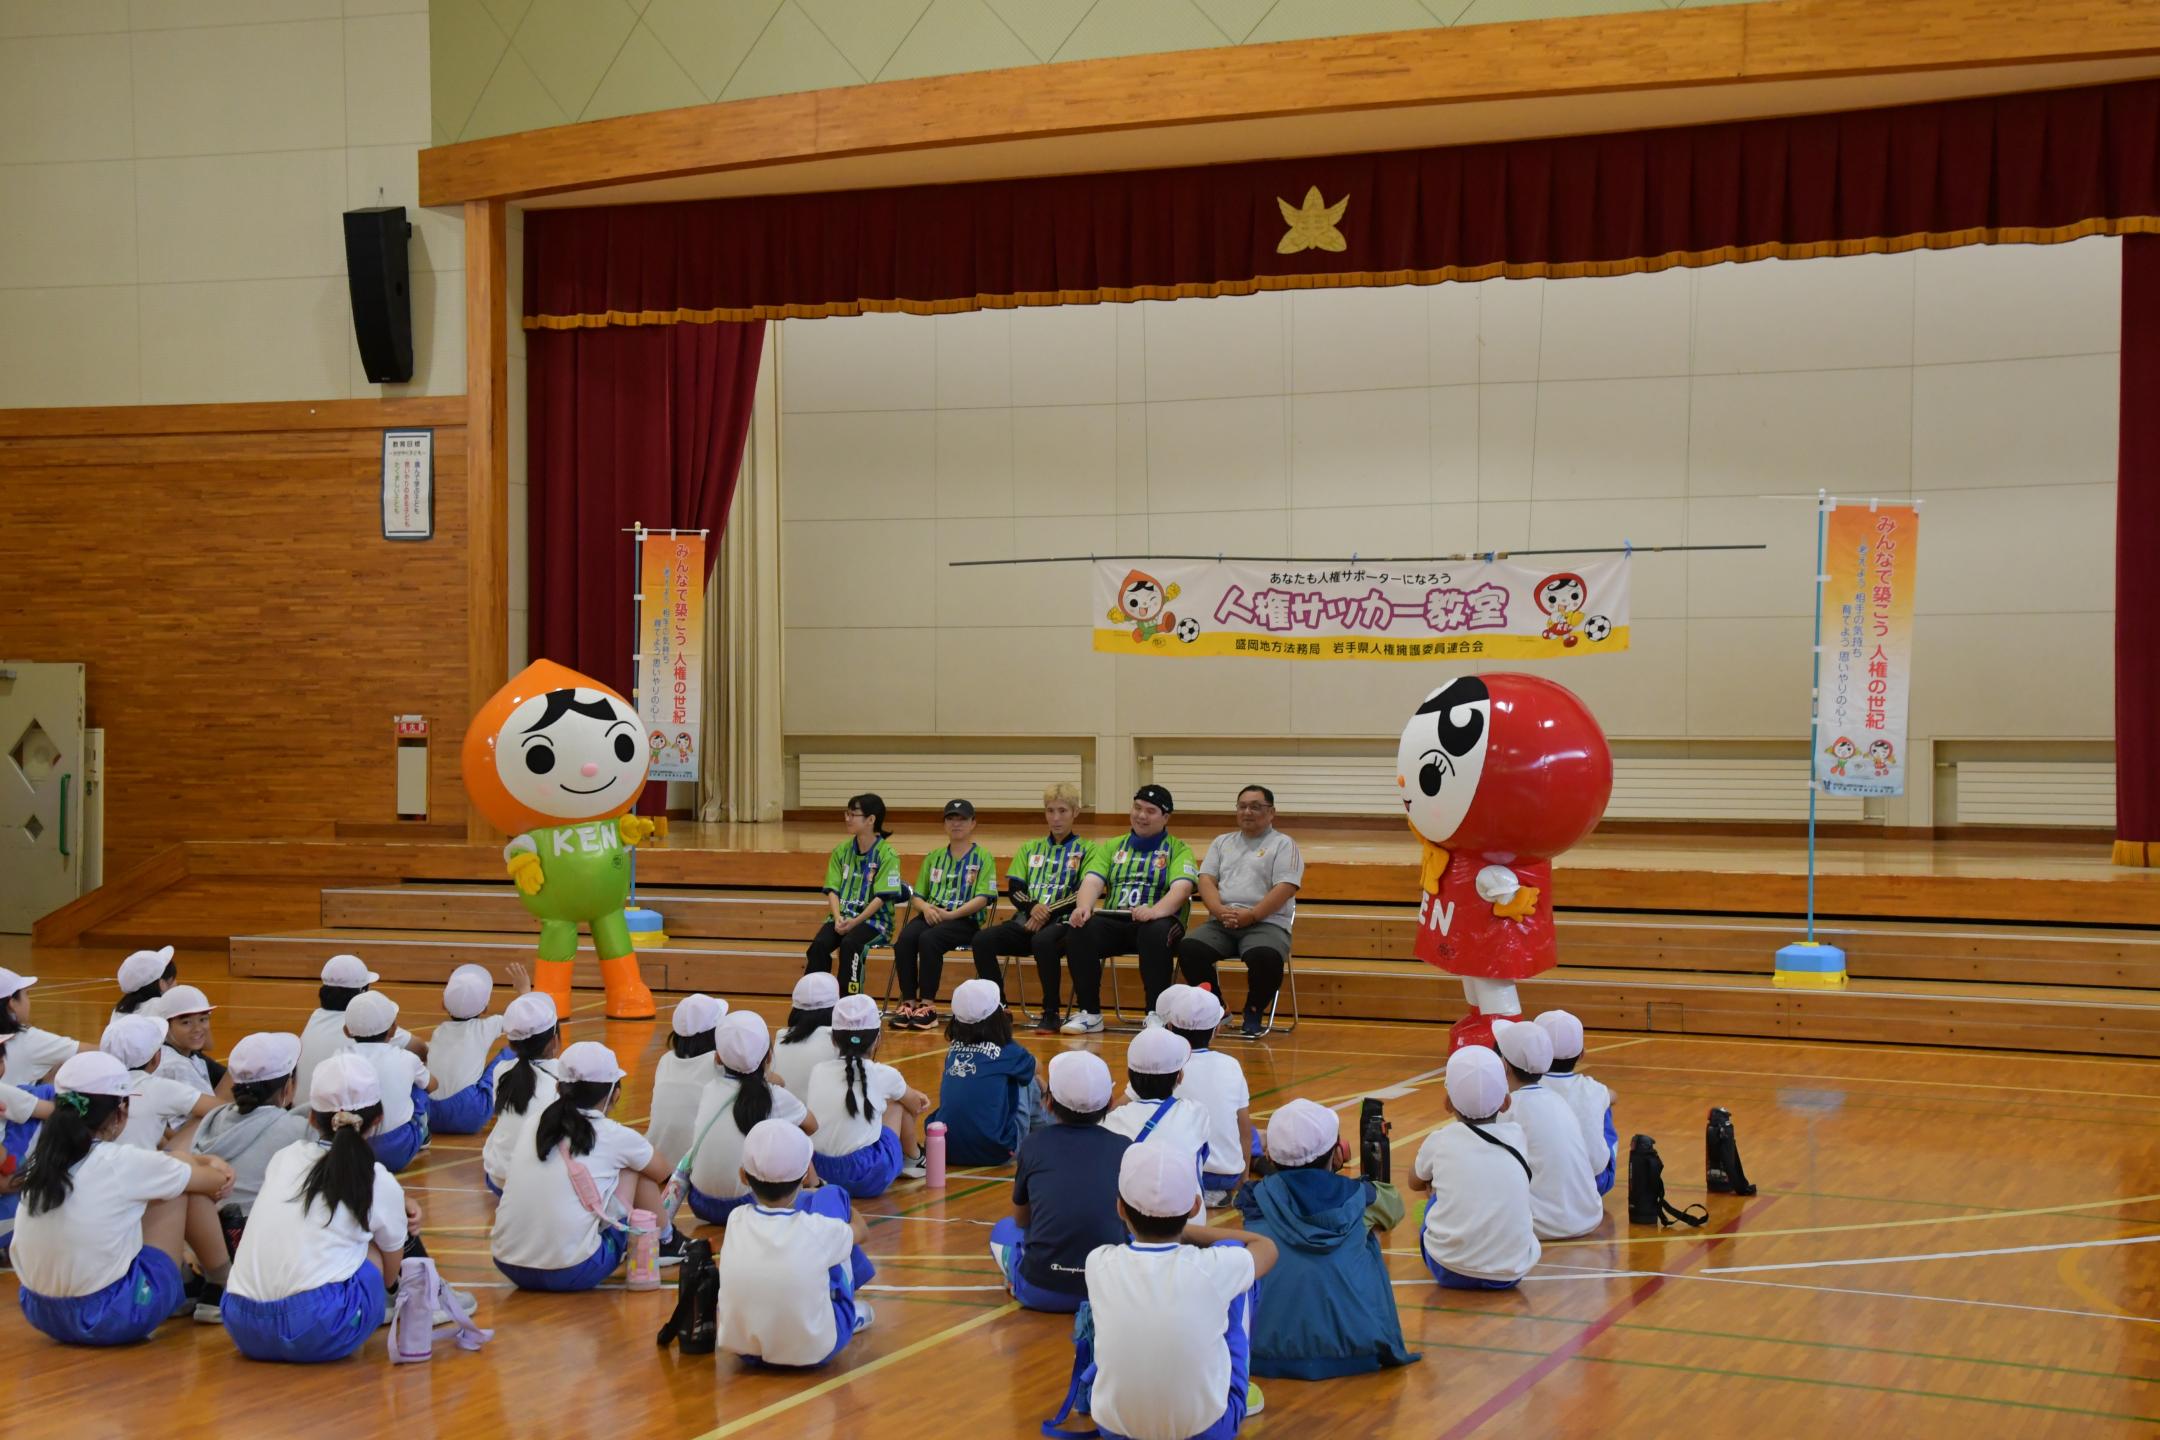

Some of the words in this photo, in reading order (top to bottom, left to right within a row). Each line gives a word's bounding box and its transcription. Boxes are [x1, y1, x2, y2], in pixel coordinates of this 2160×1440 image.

[1270, 569, 1452, 585] あなたも人権サポーターになろう
[1872, 515, 1897, 637] みんなで築こう
[675, 544, 689, 646] みんなで築こう
[1214, 582, 1510, 632] 人権サッカー教室
[1236, 639, 1320, 655] 盛岡地方法務局
[1333, 640, 1484, 656] 岩手県人権擁護委員連合会
[672, 651, 687, 724] 人権の世紀
[1865, 644, 1889, 730] 人権の世紀
[553, 822, 618, 857] KEN
[1043, 894, 1051, 905] 7
[1117, 888, 1141, 907] 20
[851, 952, 859, 982] lotto
